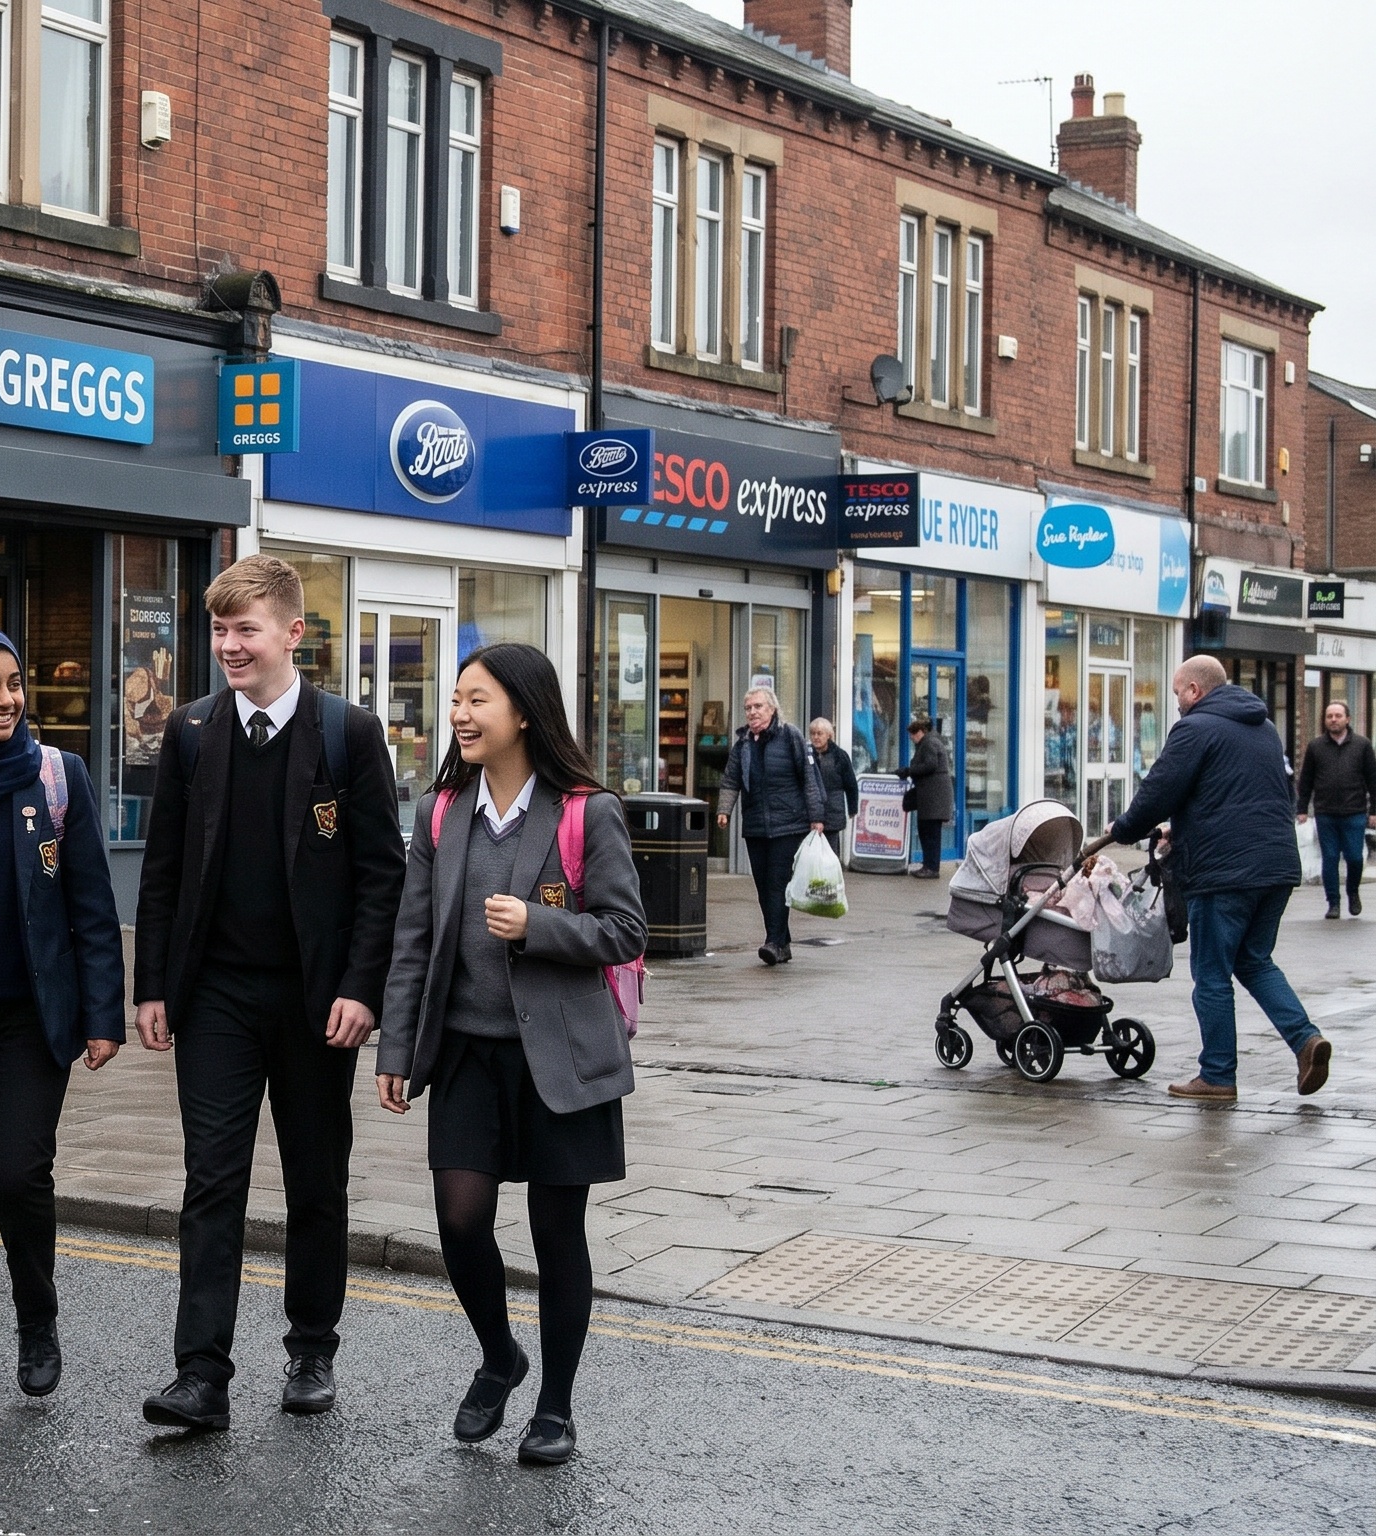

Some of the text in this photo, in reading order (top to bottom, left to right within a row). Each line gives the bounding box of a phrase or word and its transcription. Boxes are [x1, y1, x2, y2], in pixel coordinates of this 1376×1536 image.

[232, 433, 281, 446] GREGGS
[408, 421, 469, 477] Boots
[577, 480, 638, 498] express
[653, 453, 827, 534] ESCO express
[844, 482, 910, 497] TESCO
[844, 503, 910, 521] express
[921, 497, 998, 550] UE RYDER
[1042, 523, 1067, 547] Sue
